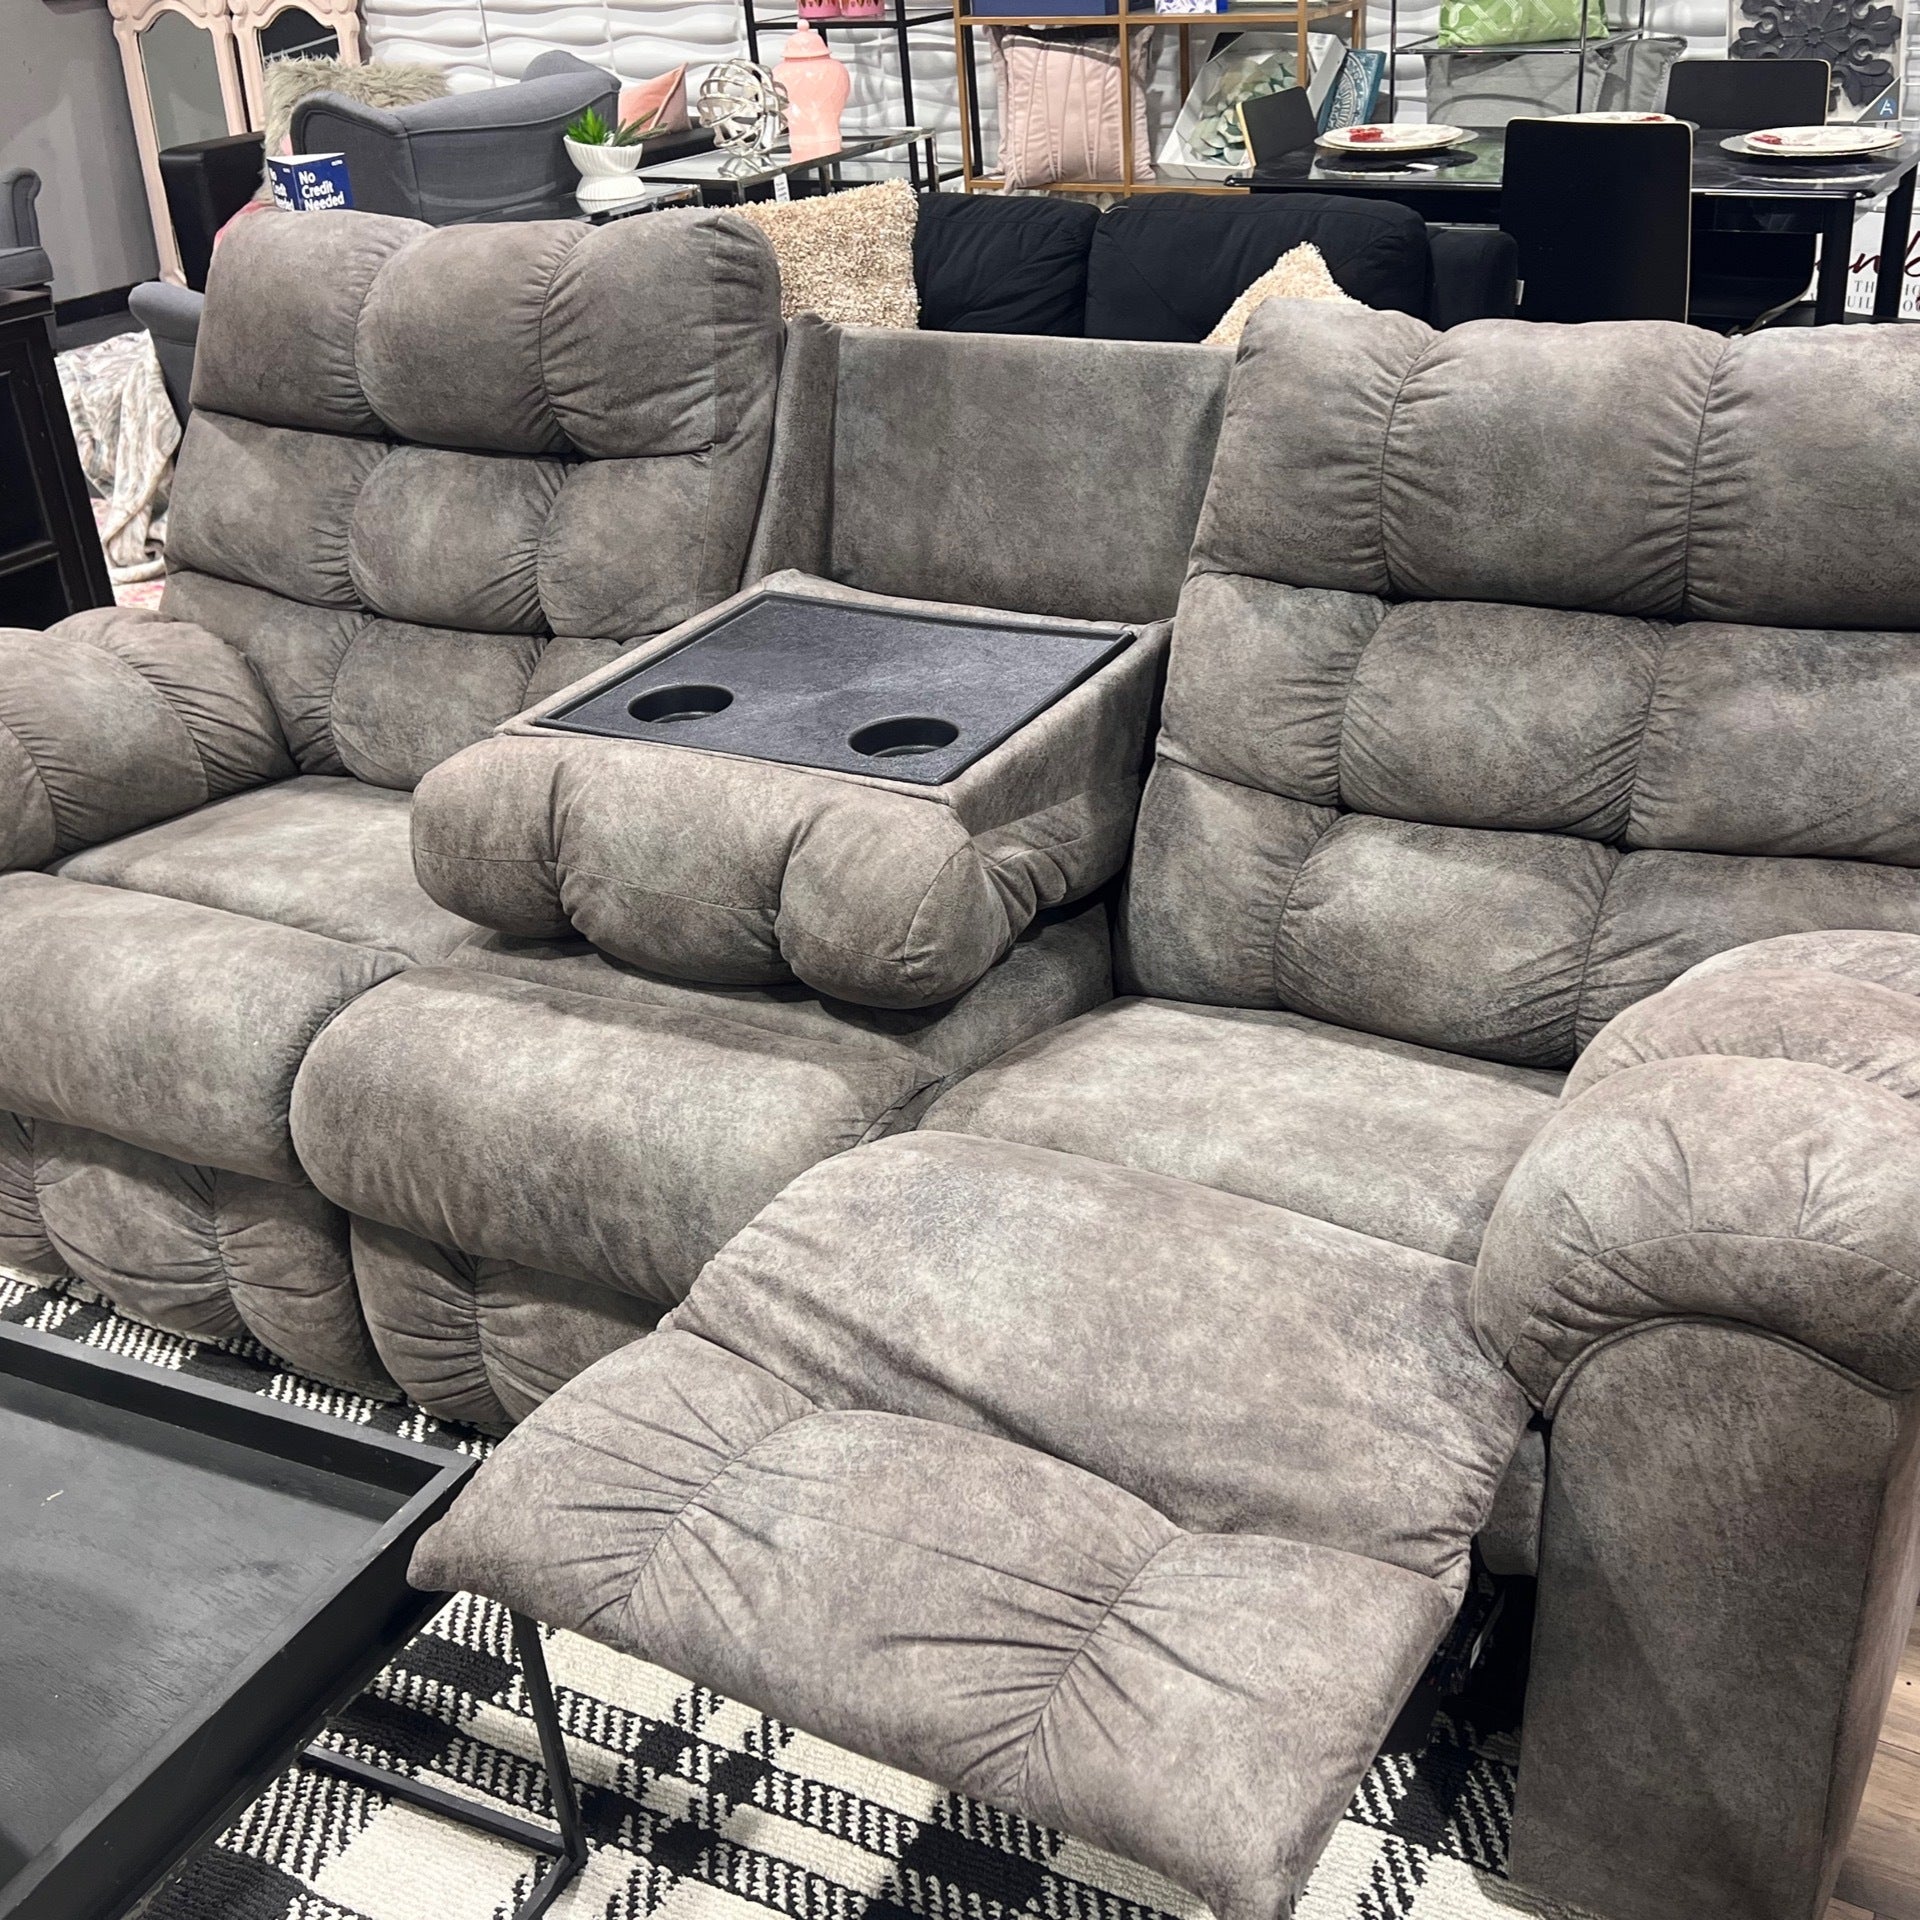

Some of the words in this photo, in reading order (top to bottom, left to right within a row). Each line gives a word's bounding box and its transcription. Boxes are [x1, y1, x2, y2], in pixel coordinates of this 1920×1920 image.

[298, 170, 316, 185] No
[302, 180, 334, 198] Credit
[304, 190, 345, 211] Needed
